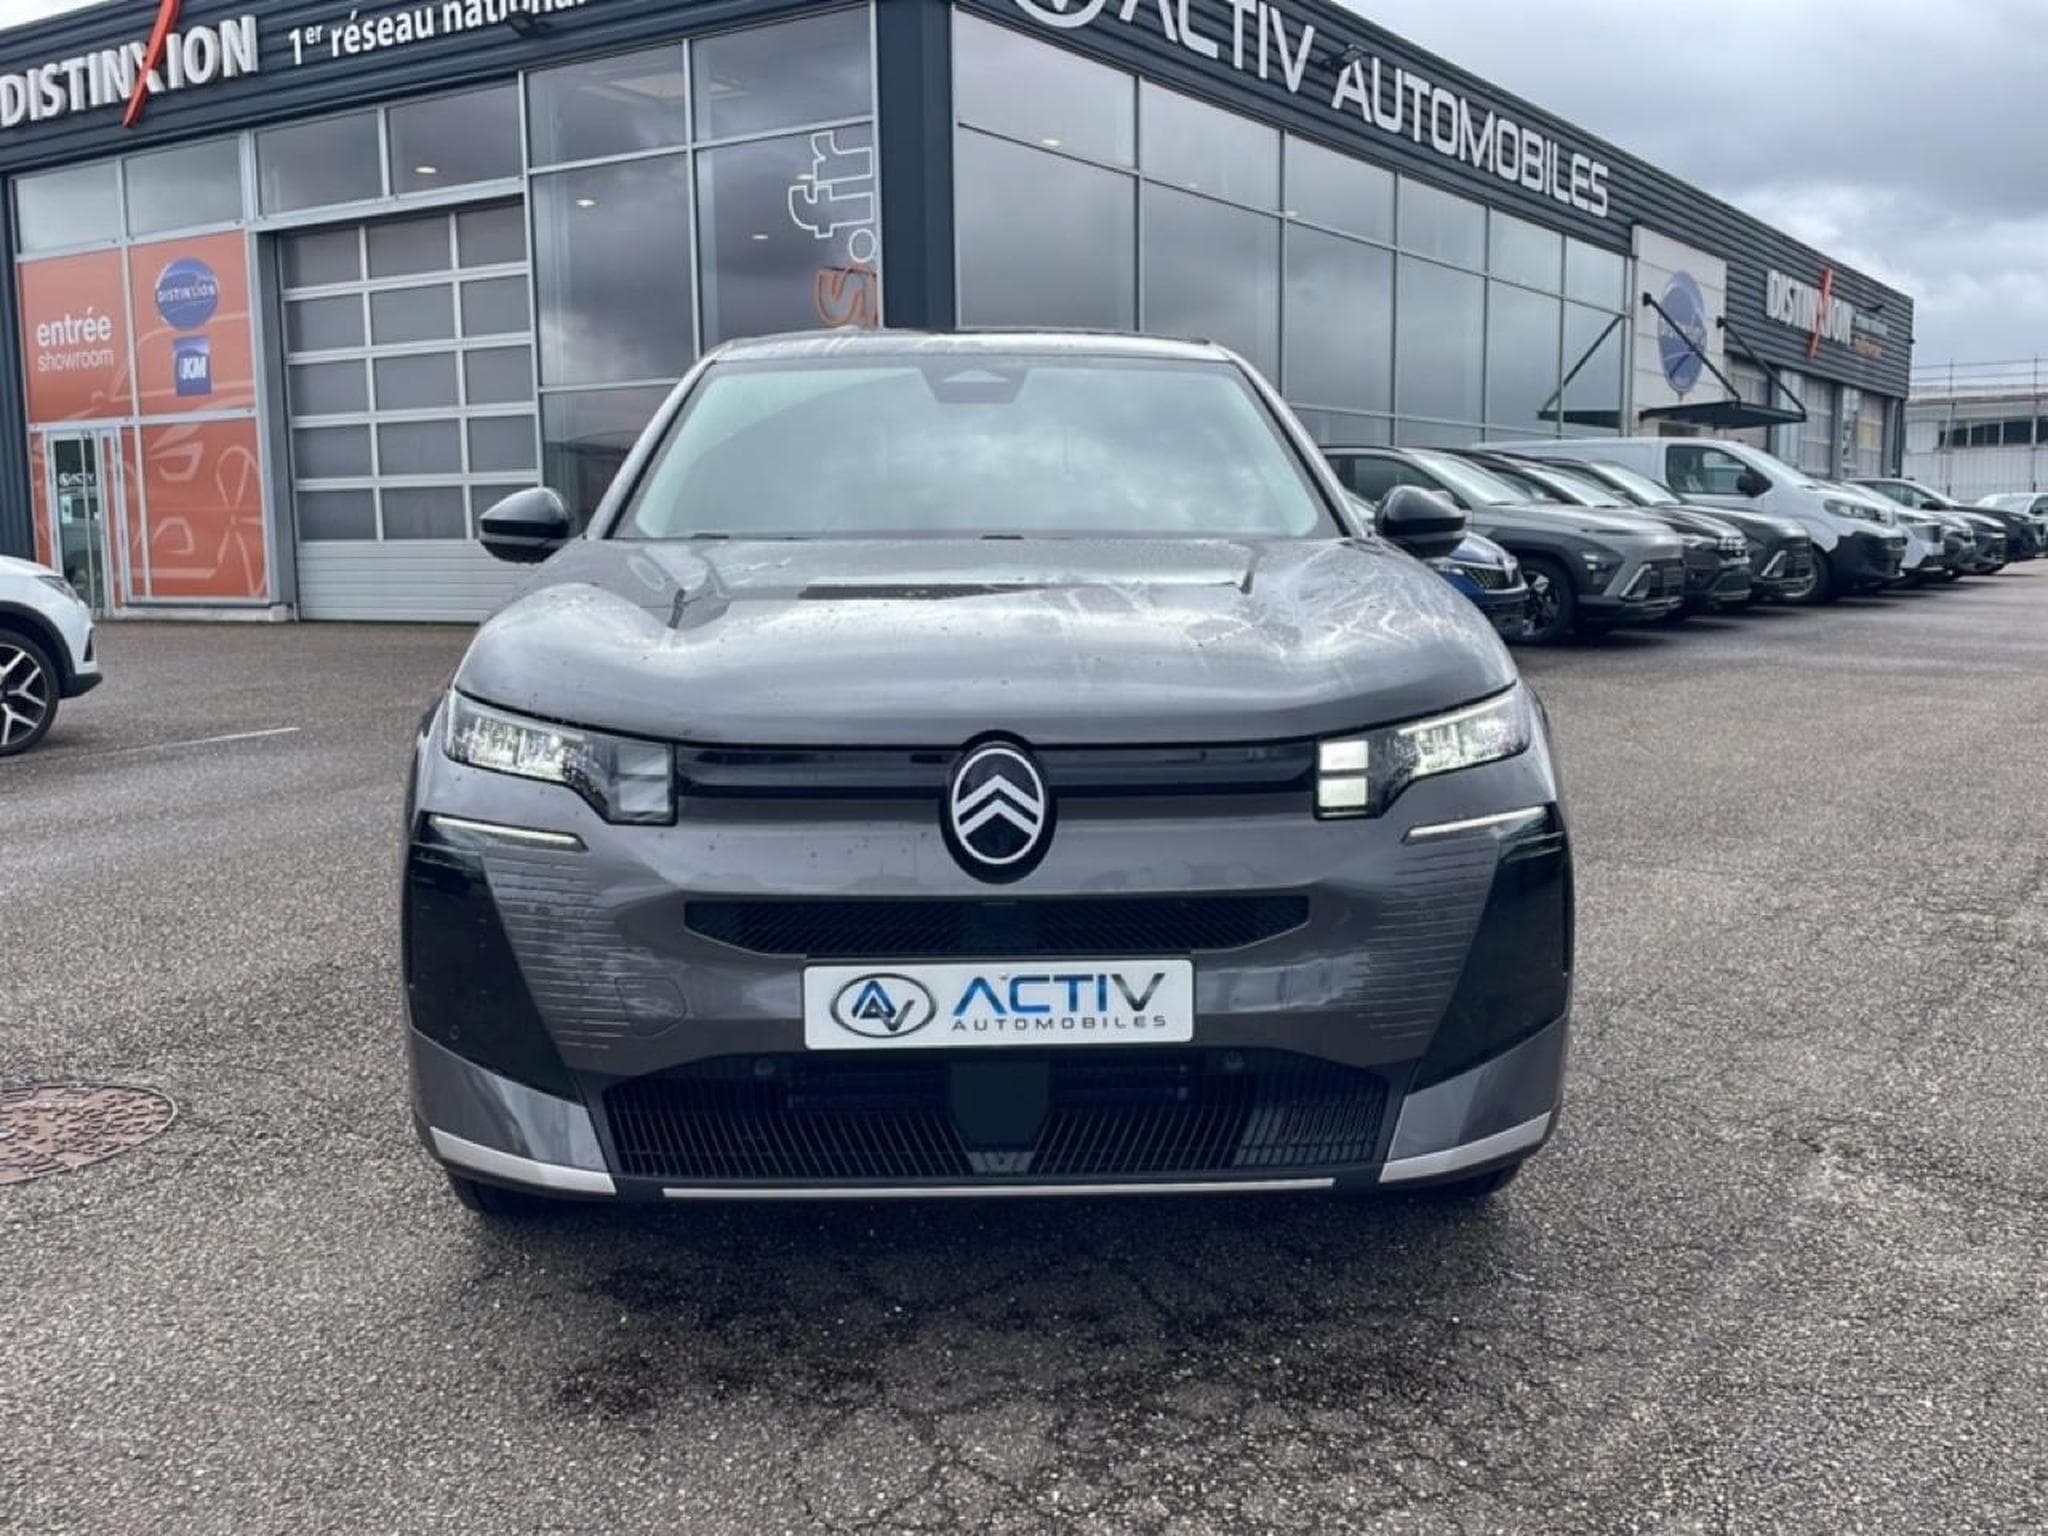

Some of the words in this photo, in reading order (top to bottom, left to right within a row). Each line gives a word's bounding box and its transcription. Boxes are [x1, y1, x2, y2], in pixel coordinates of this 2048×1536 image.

[330, 6, 435, 58] réseau
[0, 0, 260, 128] DISTINXION
[1331, 55, 1609, 218] AUTOMOBILES
[36, 306, 112, 348] entrée
[37, 349, 114, 373] showroom
[952, 973, 1166, 1017] ACTIV
[951, 1015, 1167, 1032] AUTOMOBILES
